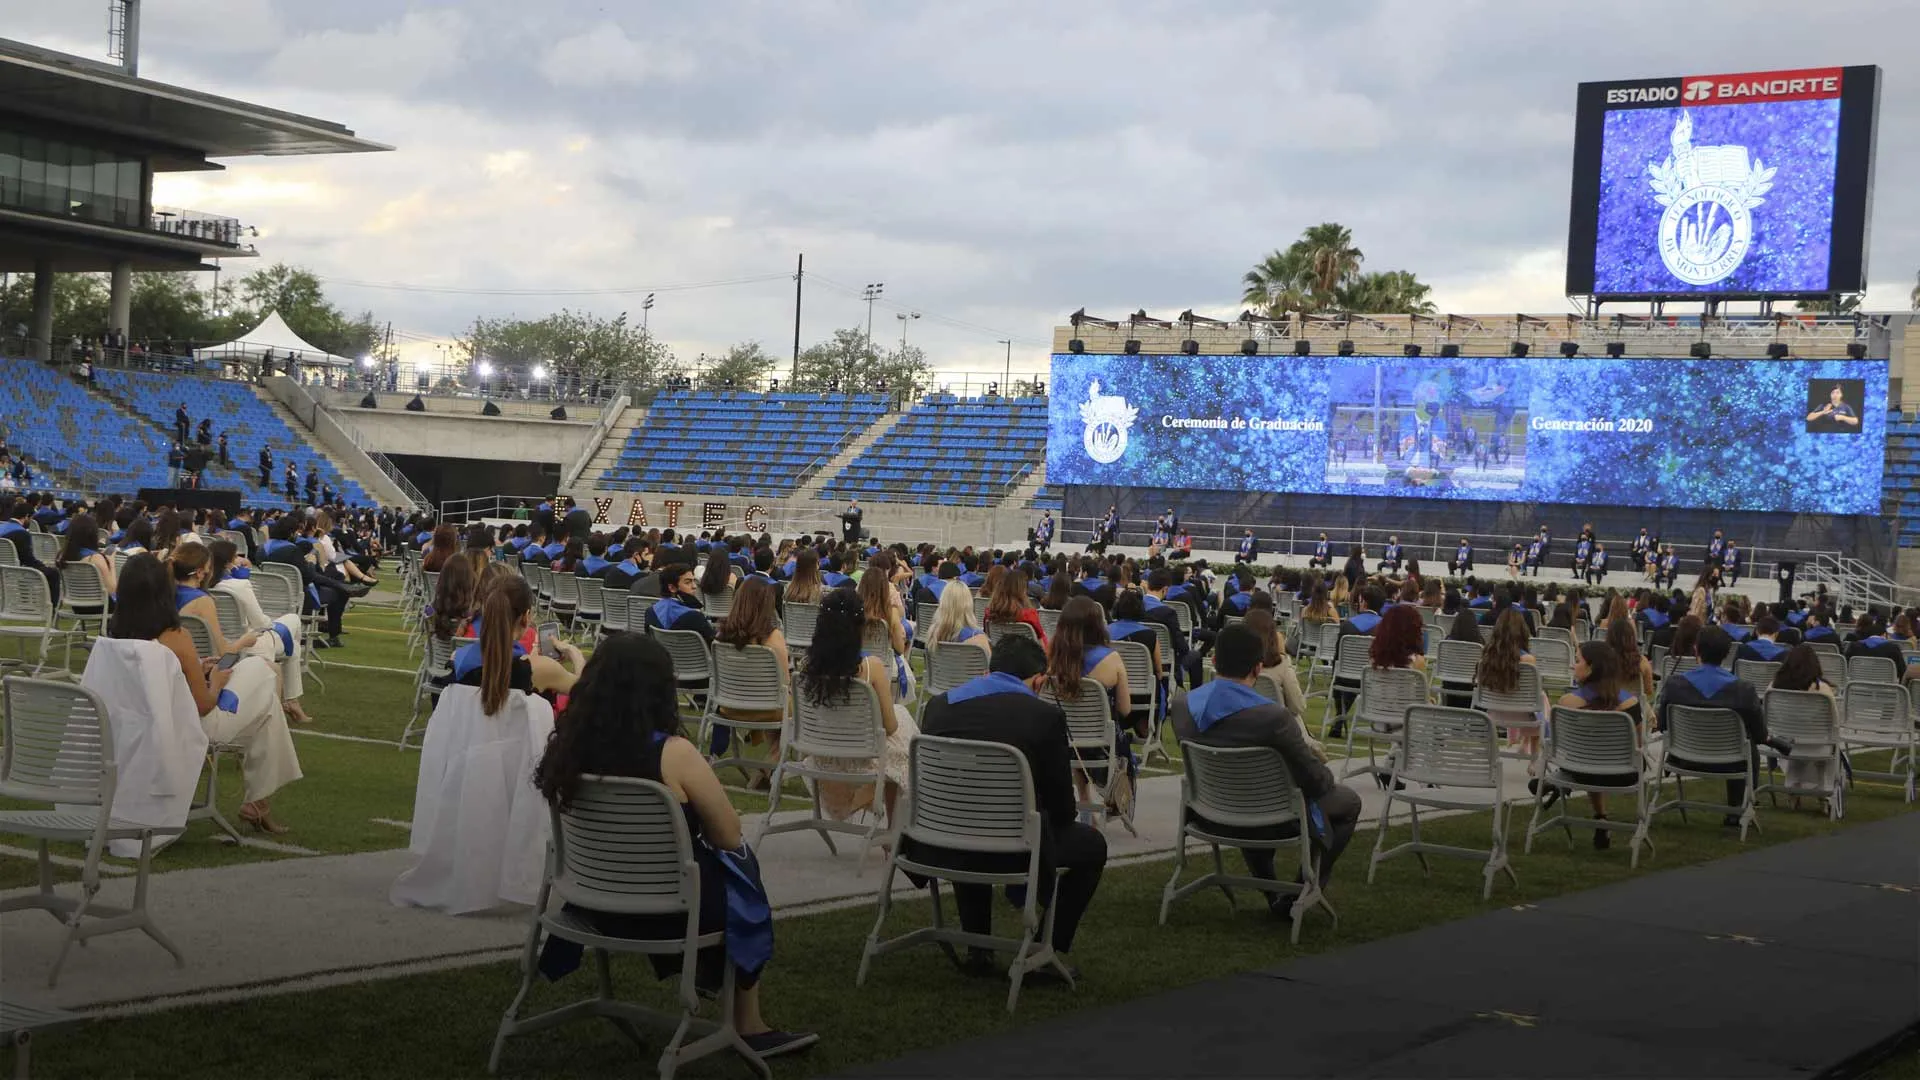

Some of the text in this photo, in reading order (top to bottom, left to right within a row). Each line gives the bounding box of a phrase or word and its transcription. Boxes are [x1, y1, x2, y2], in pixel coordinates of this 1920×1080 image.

[1606, 77, 1839, 104] ESTADIO BANORTE
[1161, 415, 1324, 432] Ceremonia de Graduación
[1532, 416, 1654, 433] Generación 2020
